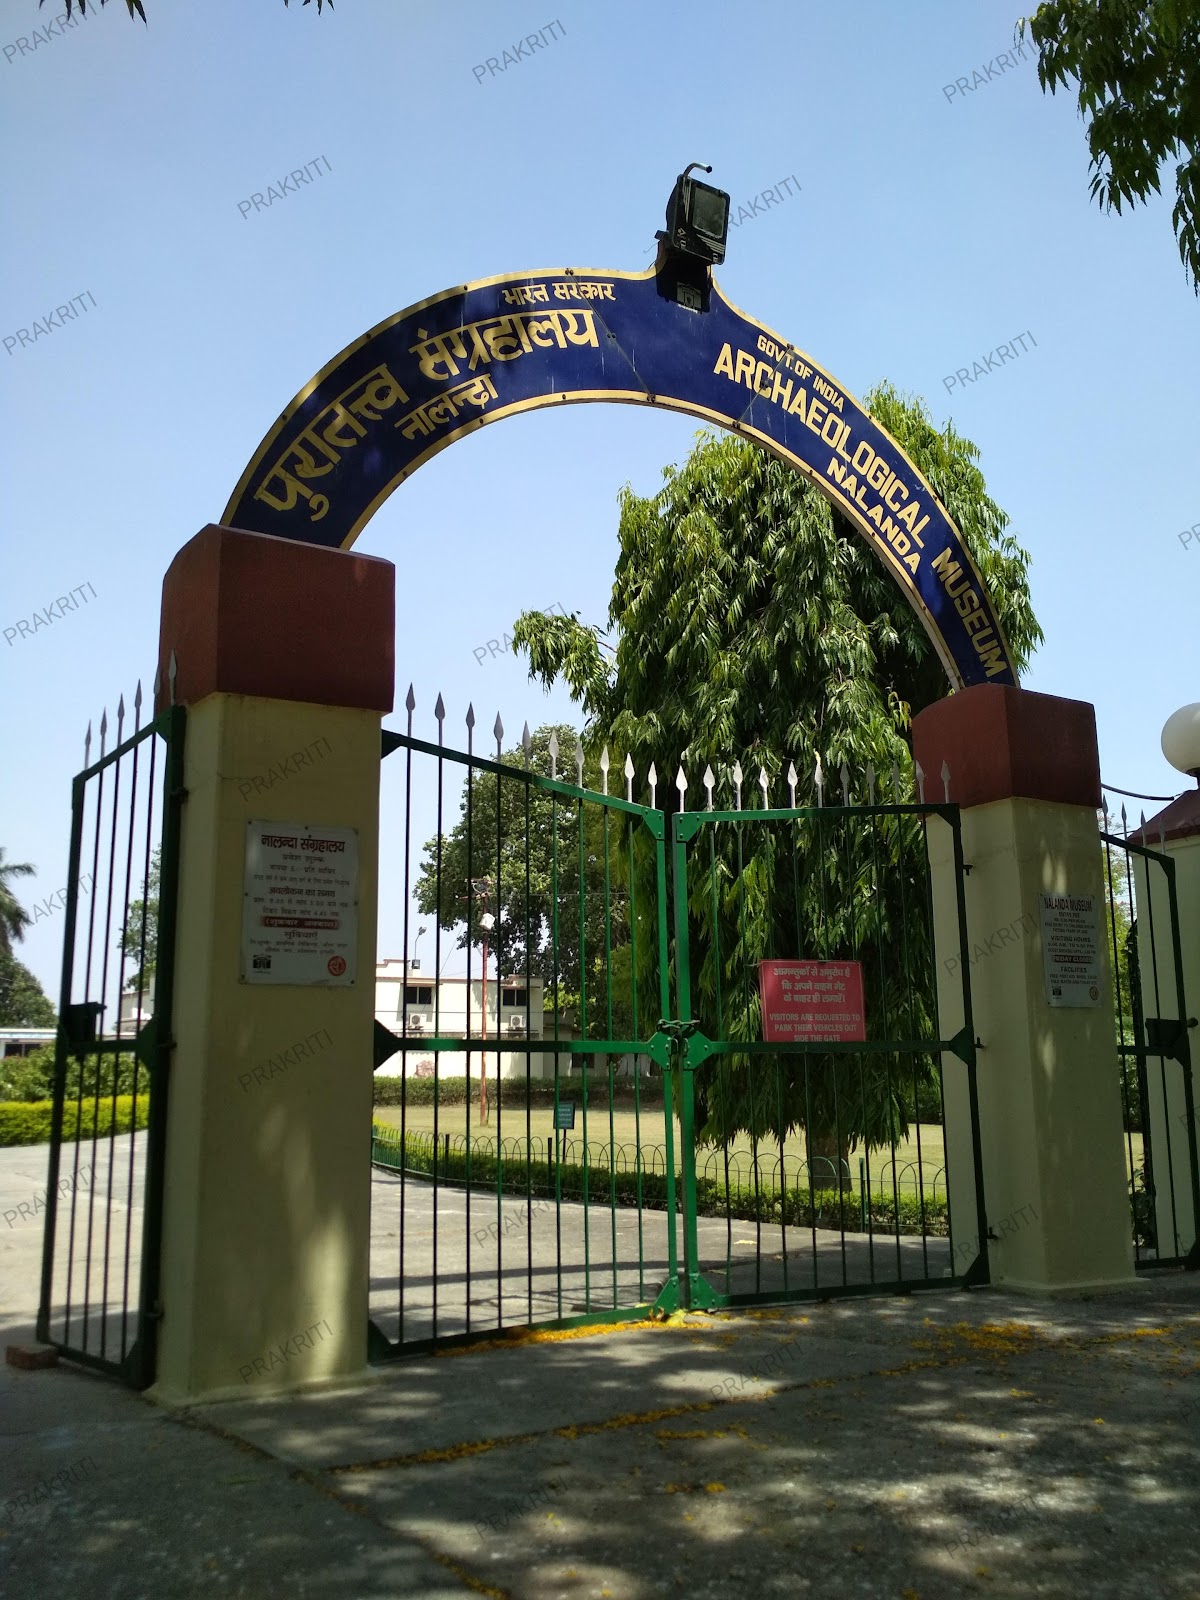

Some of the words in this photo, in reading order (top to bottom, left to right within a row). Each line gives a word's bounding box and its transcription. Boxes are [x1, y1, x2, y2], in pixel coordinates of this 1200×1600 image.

[502, 284, 549, 305] भारत
[552, 282, 616, 300] सरकार
[409, 308, 600, 381] संग्रहालय
[757, 334, 794, 370] GOVT.
[794, 360, 813, 379] OF
[812, 375, 844, 412] INDIA
[395, 373, 499, 440] नालन्दा
[713, 343, 932, 549] ARCHAEOLOGICAL
[931, 547, 1008, 677] MUSEUM
[827, 457, 921, 574] NALANDA
[261, 834, 298, 849] नालन्दा
[299, 834, 346, 853] संग्रहालय
[1043, 897, 1070, 910] NALANDA
[1069, 899, 1093, 912] MUSEUM
[810, 966, 819, 976] से
[819, 966, 843, 980] अनुरोध
[844, 966, 851, 978] है
[781, 979, 792, 990] कि
[793, 980, 813, 991] अपने
[782, 991, 792, 1002] के
[811, 991, 821, 1003] ही
[769, 1013, 800, 1021] VISITORS
[800, 1013, 814, 1021] ARE
[814, 1013, 850, 1021] REQUESTED
[851, 1013, 861, 1021] TO
[774, 1023, 793, 1032] PARK
[793, 1023, 813, 1032] THEIR
[813, 1023, 844, 1032] VEHICLES
[844, 1024, 857, 1032] OUT
[793, 1034, 809, 1042] SIDE
[809, 1034, 823, 1042] THE
[823, 1034, 841, 1042] GATE
